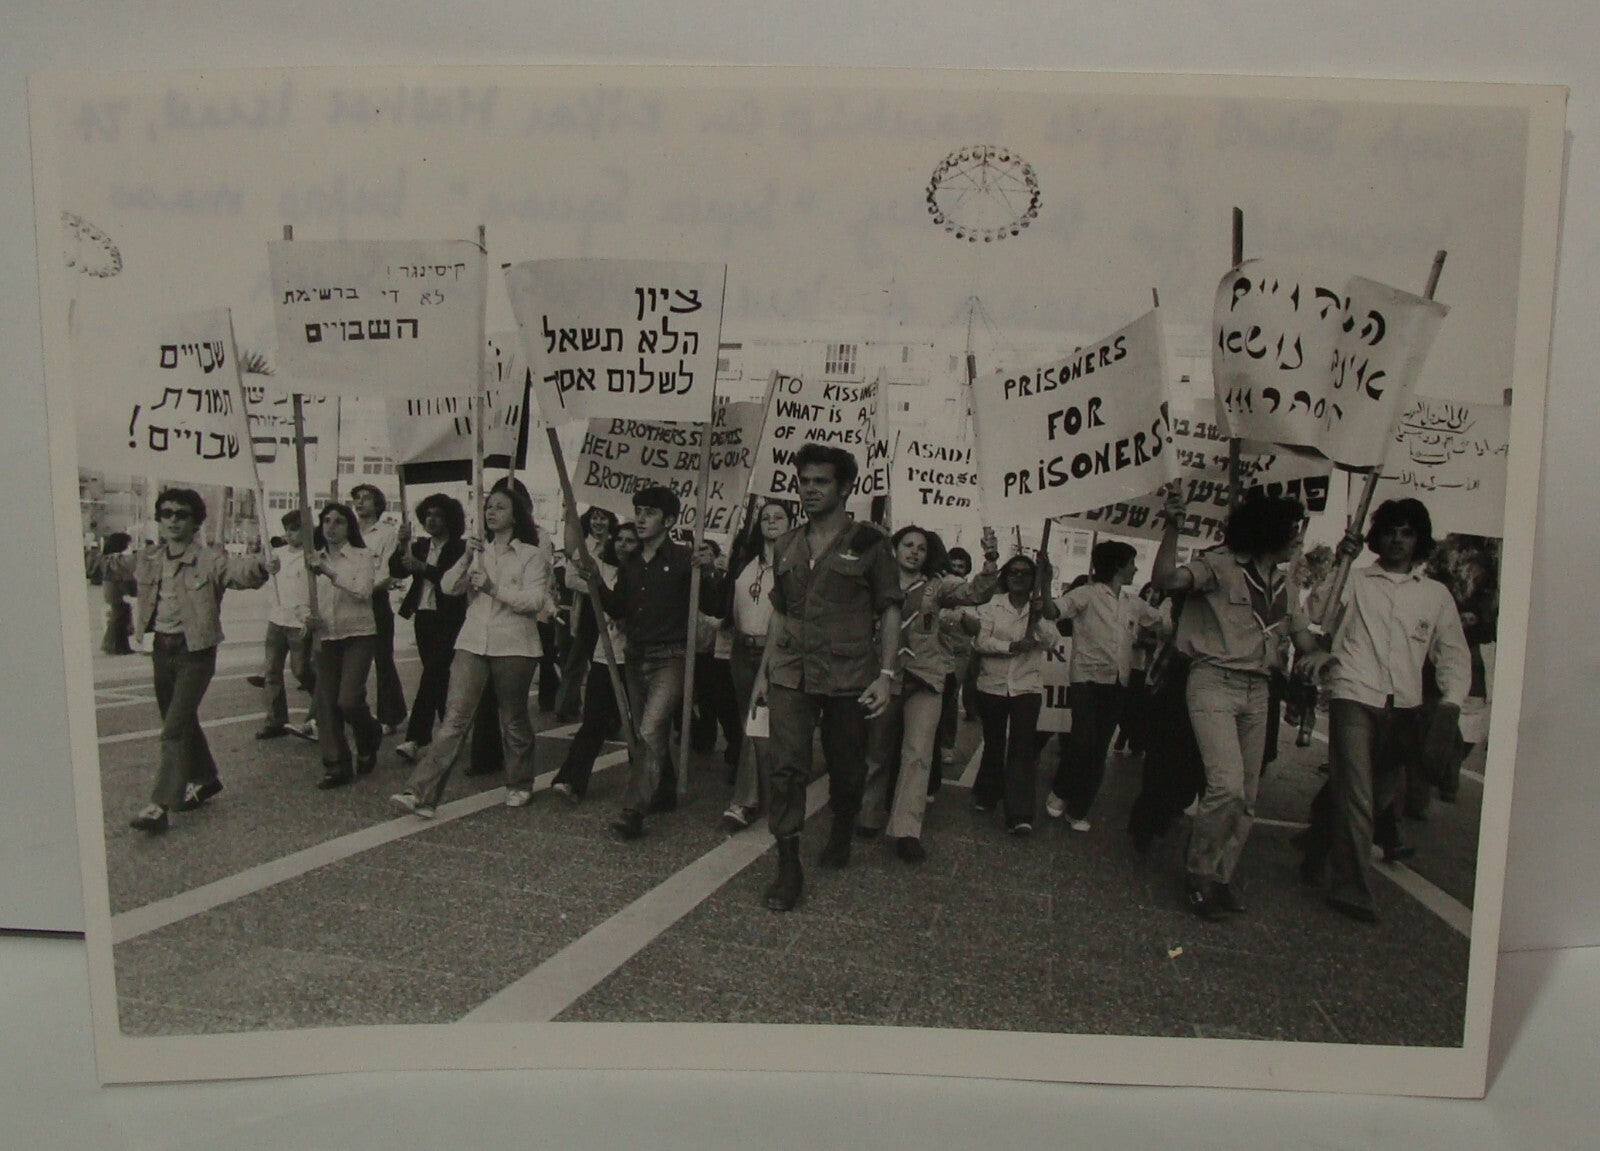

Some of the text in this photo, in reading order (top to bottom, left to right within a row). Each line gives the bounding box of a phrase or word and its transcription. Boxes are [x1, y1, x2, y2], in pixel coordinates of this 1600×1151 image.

[282, 287, 360, 305] ברשימת
[418, 289, 445, 306] לא
[635, 287, 702, 321] ציון
[304, 318, 419, 344] השבויים
[542, 314, 699, 355] הלא תשאל
[160, 341, 225, 374] שבויים
[606, 357, 695, 396] לשלום
[777, 376, 803, 394] TO
[150, 387, 233, 417] תמורת
[776, 398, 825, 422] WHAT
[1047, 397, 1105, 440] FOR
[773, 425, 796, 440] OF
[804, 427, 862, 445] NAMES
[580, 431, 631, 461] HELP
[640, 446, 670, 469] US
[906, 440, 973, 466] ASAD!
[918, 488, 972, 508] Them
